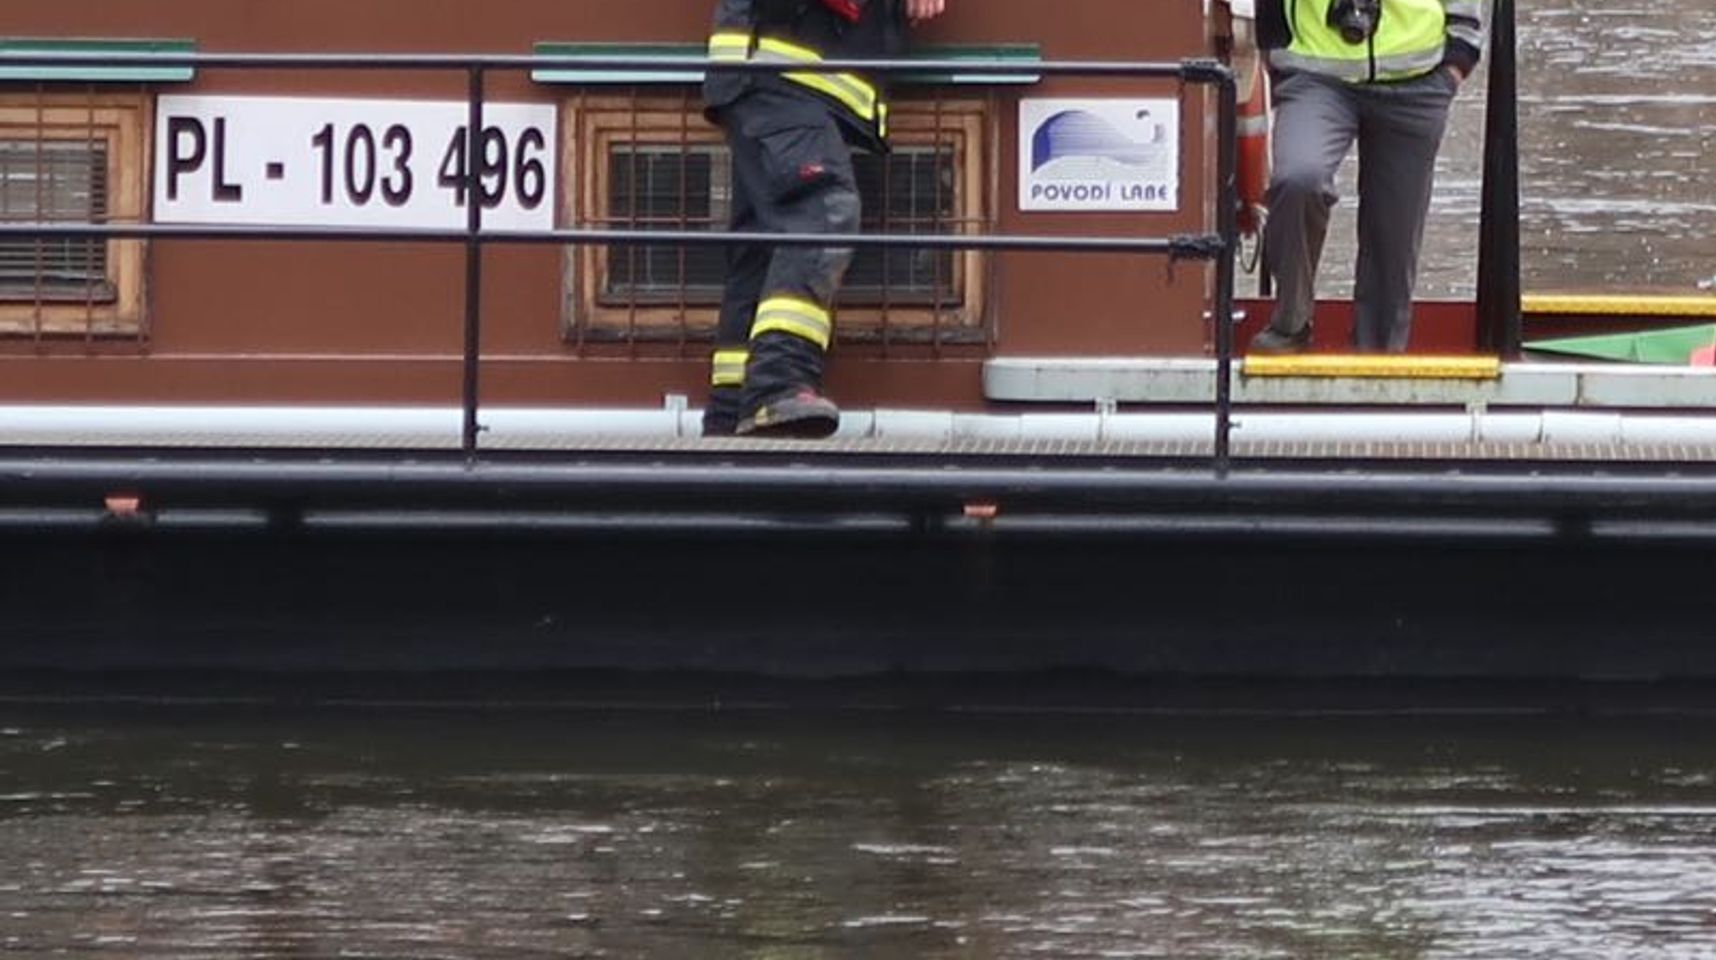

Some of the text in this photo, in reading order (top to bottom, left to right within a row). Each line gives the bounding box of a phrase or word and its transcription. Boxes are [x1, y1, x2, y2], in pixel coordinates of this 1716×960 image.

[166, 116, 242, 202] PL
[311, 123, 414, 208] 103
[437, 125, 547, 211] 496
[1031, 182, 1111, 201] POVODÍ
